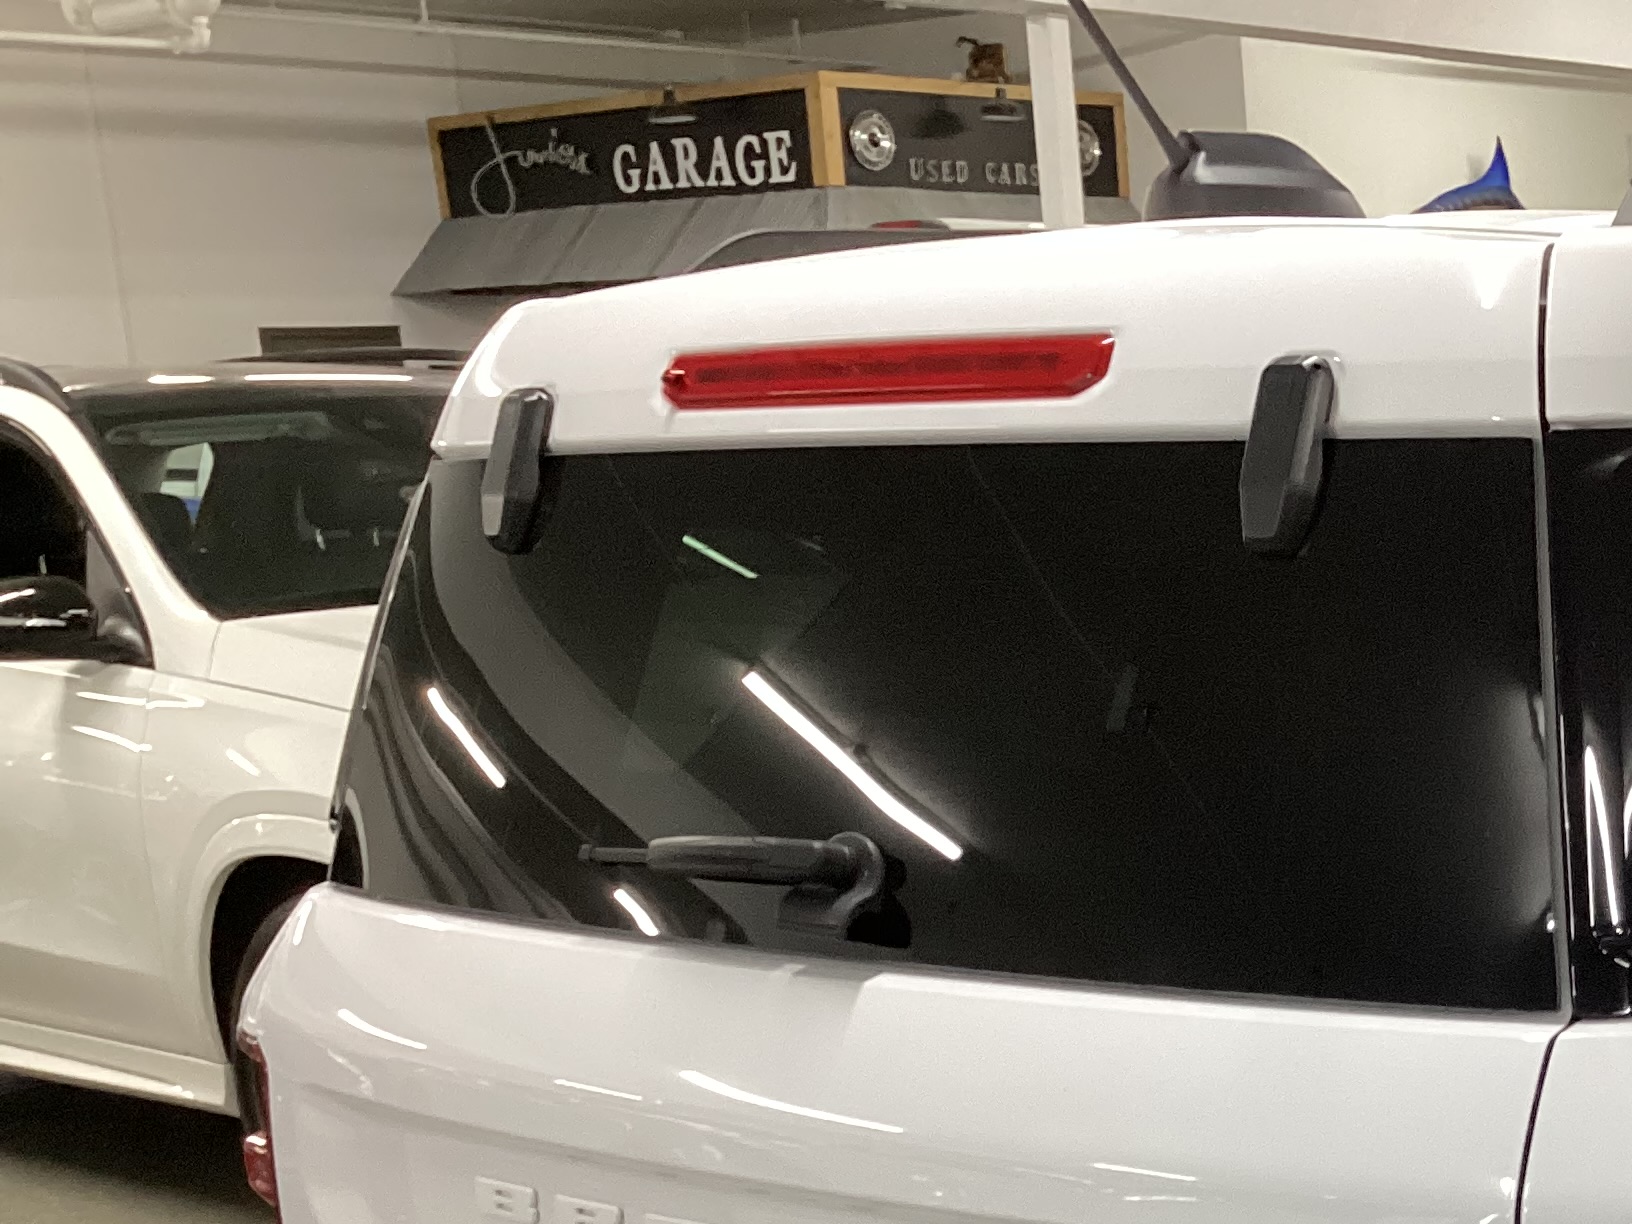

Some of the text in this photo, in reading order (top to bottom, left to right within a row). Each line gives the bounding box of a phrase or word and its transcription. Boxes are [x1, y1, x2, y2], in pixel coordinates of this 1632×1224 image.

[611, 129, 798, 194] GARAGE
[908, 157, 1039, 187] USED CARS
